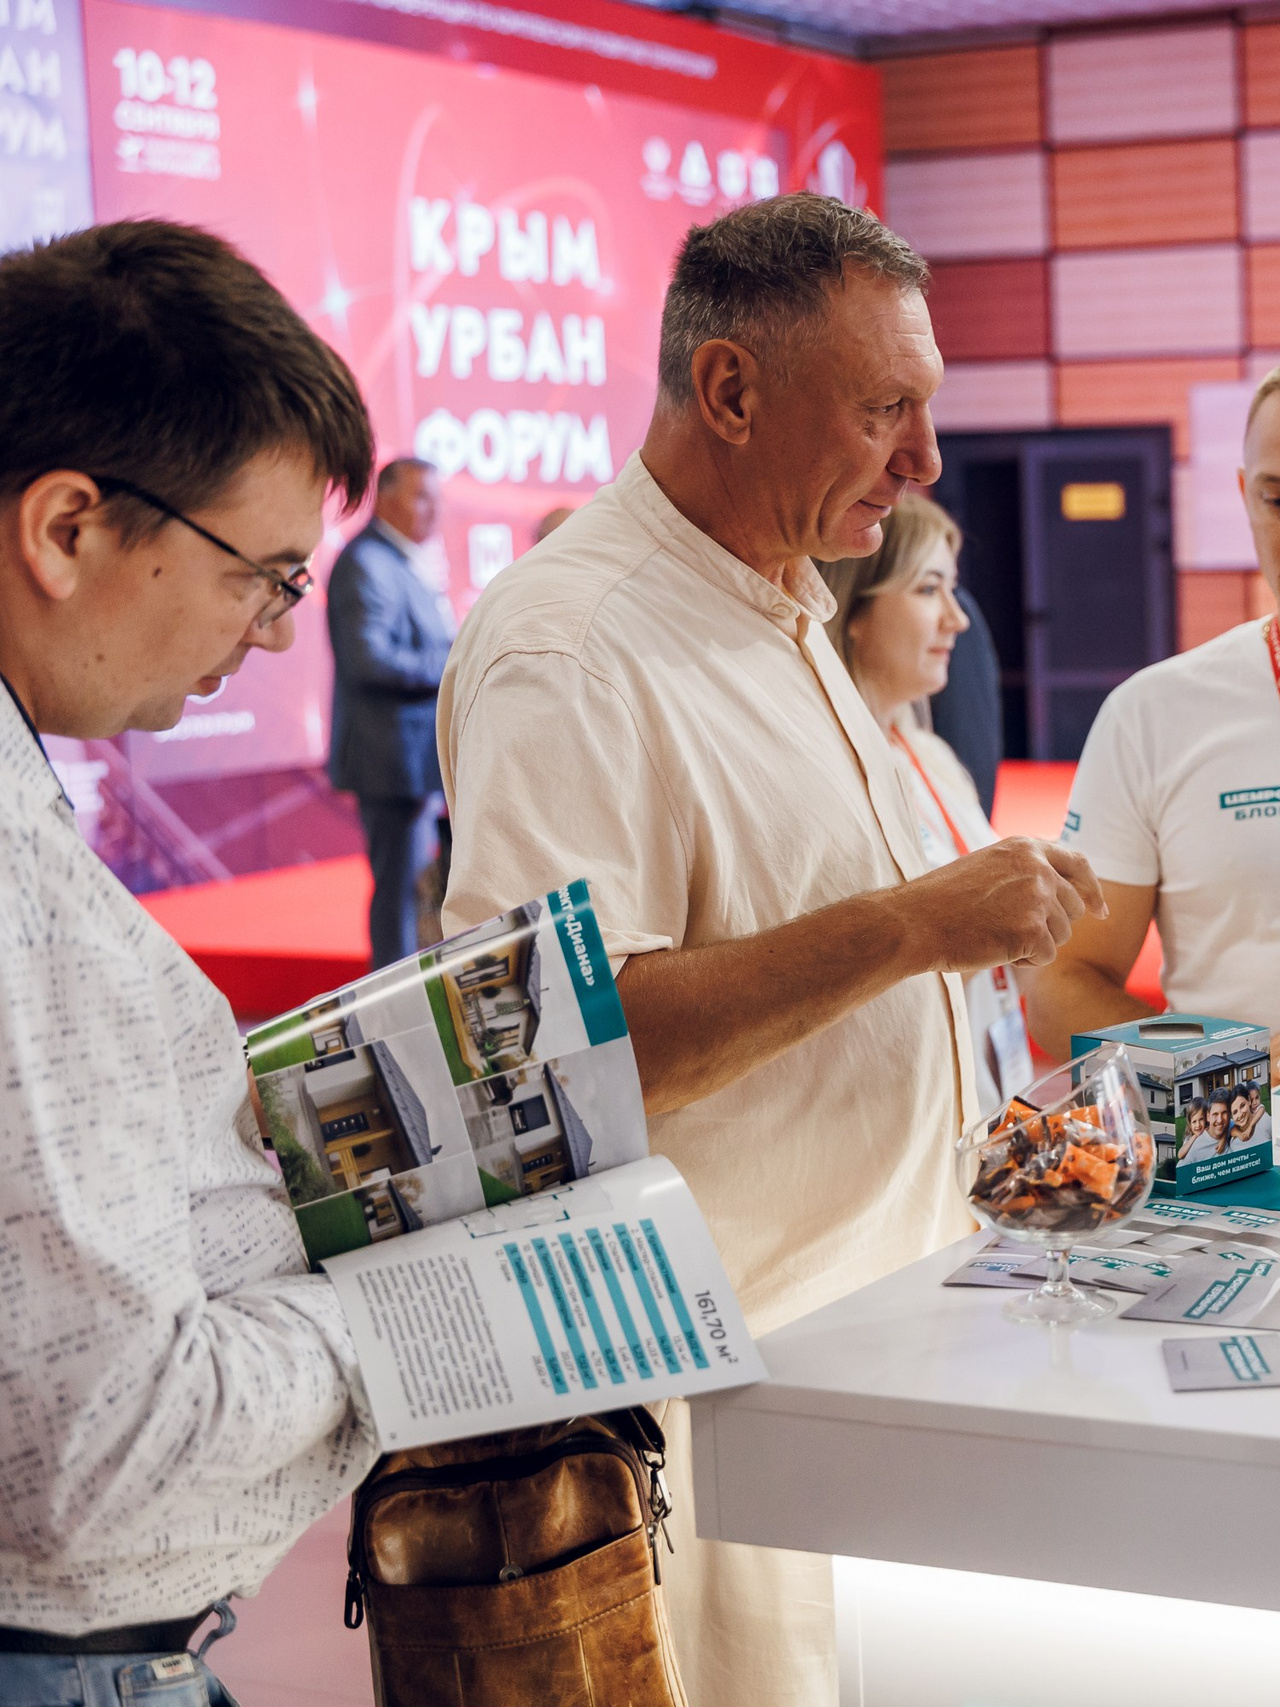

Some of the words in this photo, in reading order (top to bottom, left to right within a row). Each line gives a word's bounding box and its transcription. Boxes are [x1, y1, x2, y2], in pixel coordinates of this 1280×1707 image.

[408, 196, 601, 290] КРЫМ
[409, 302, 607, 386] УРБАН
[414, 407, 613, 484] ФОРУМ
[564, 914, 595, 986] «Диана»
[1191, 1173, 1216, 1184] ближе,
[1217, 1168, 1231, 1177] чем
[1231, 1158, 1261, 1173] кажется!
[1196, 1164, 1211, 1174] Ваш
[1212, 1160, 1227, 1170] дом
[1228, 1154, 1249, 1165] мечты
[607, 1240, 625, 1272] Спальня
[694, 1289, 726, 1341] 161,70
